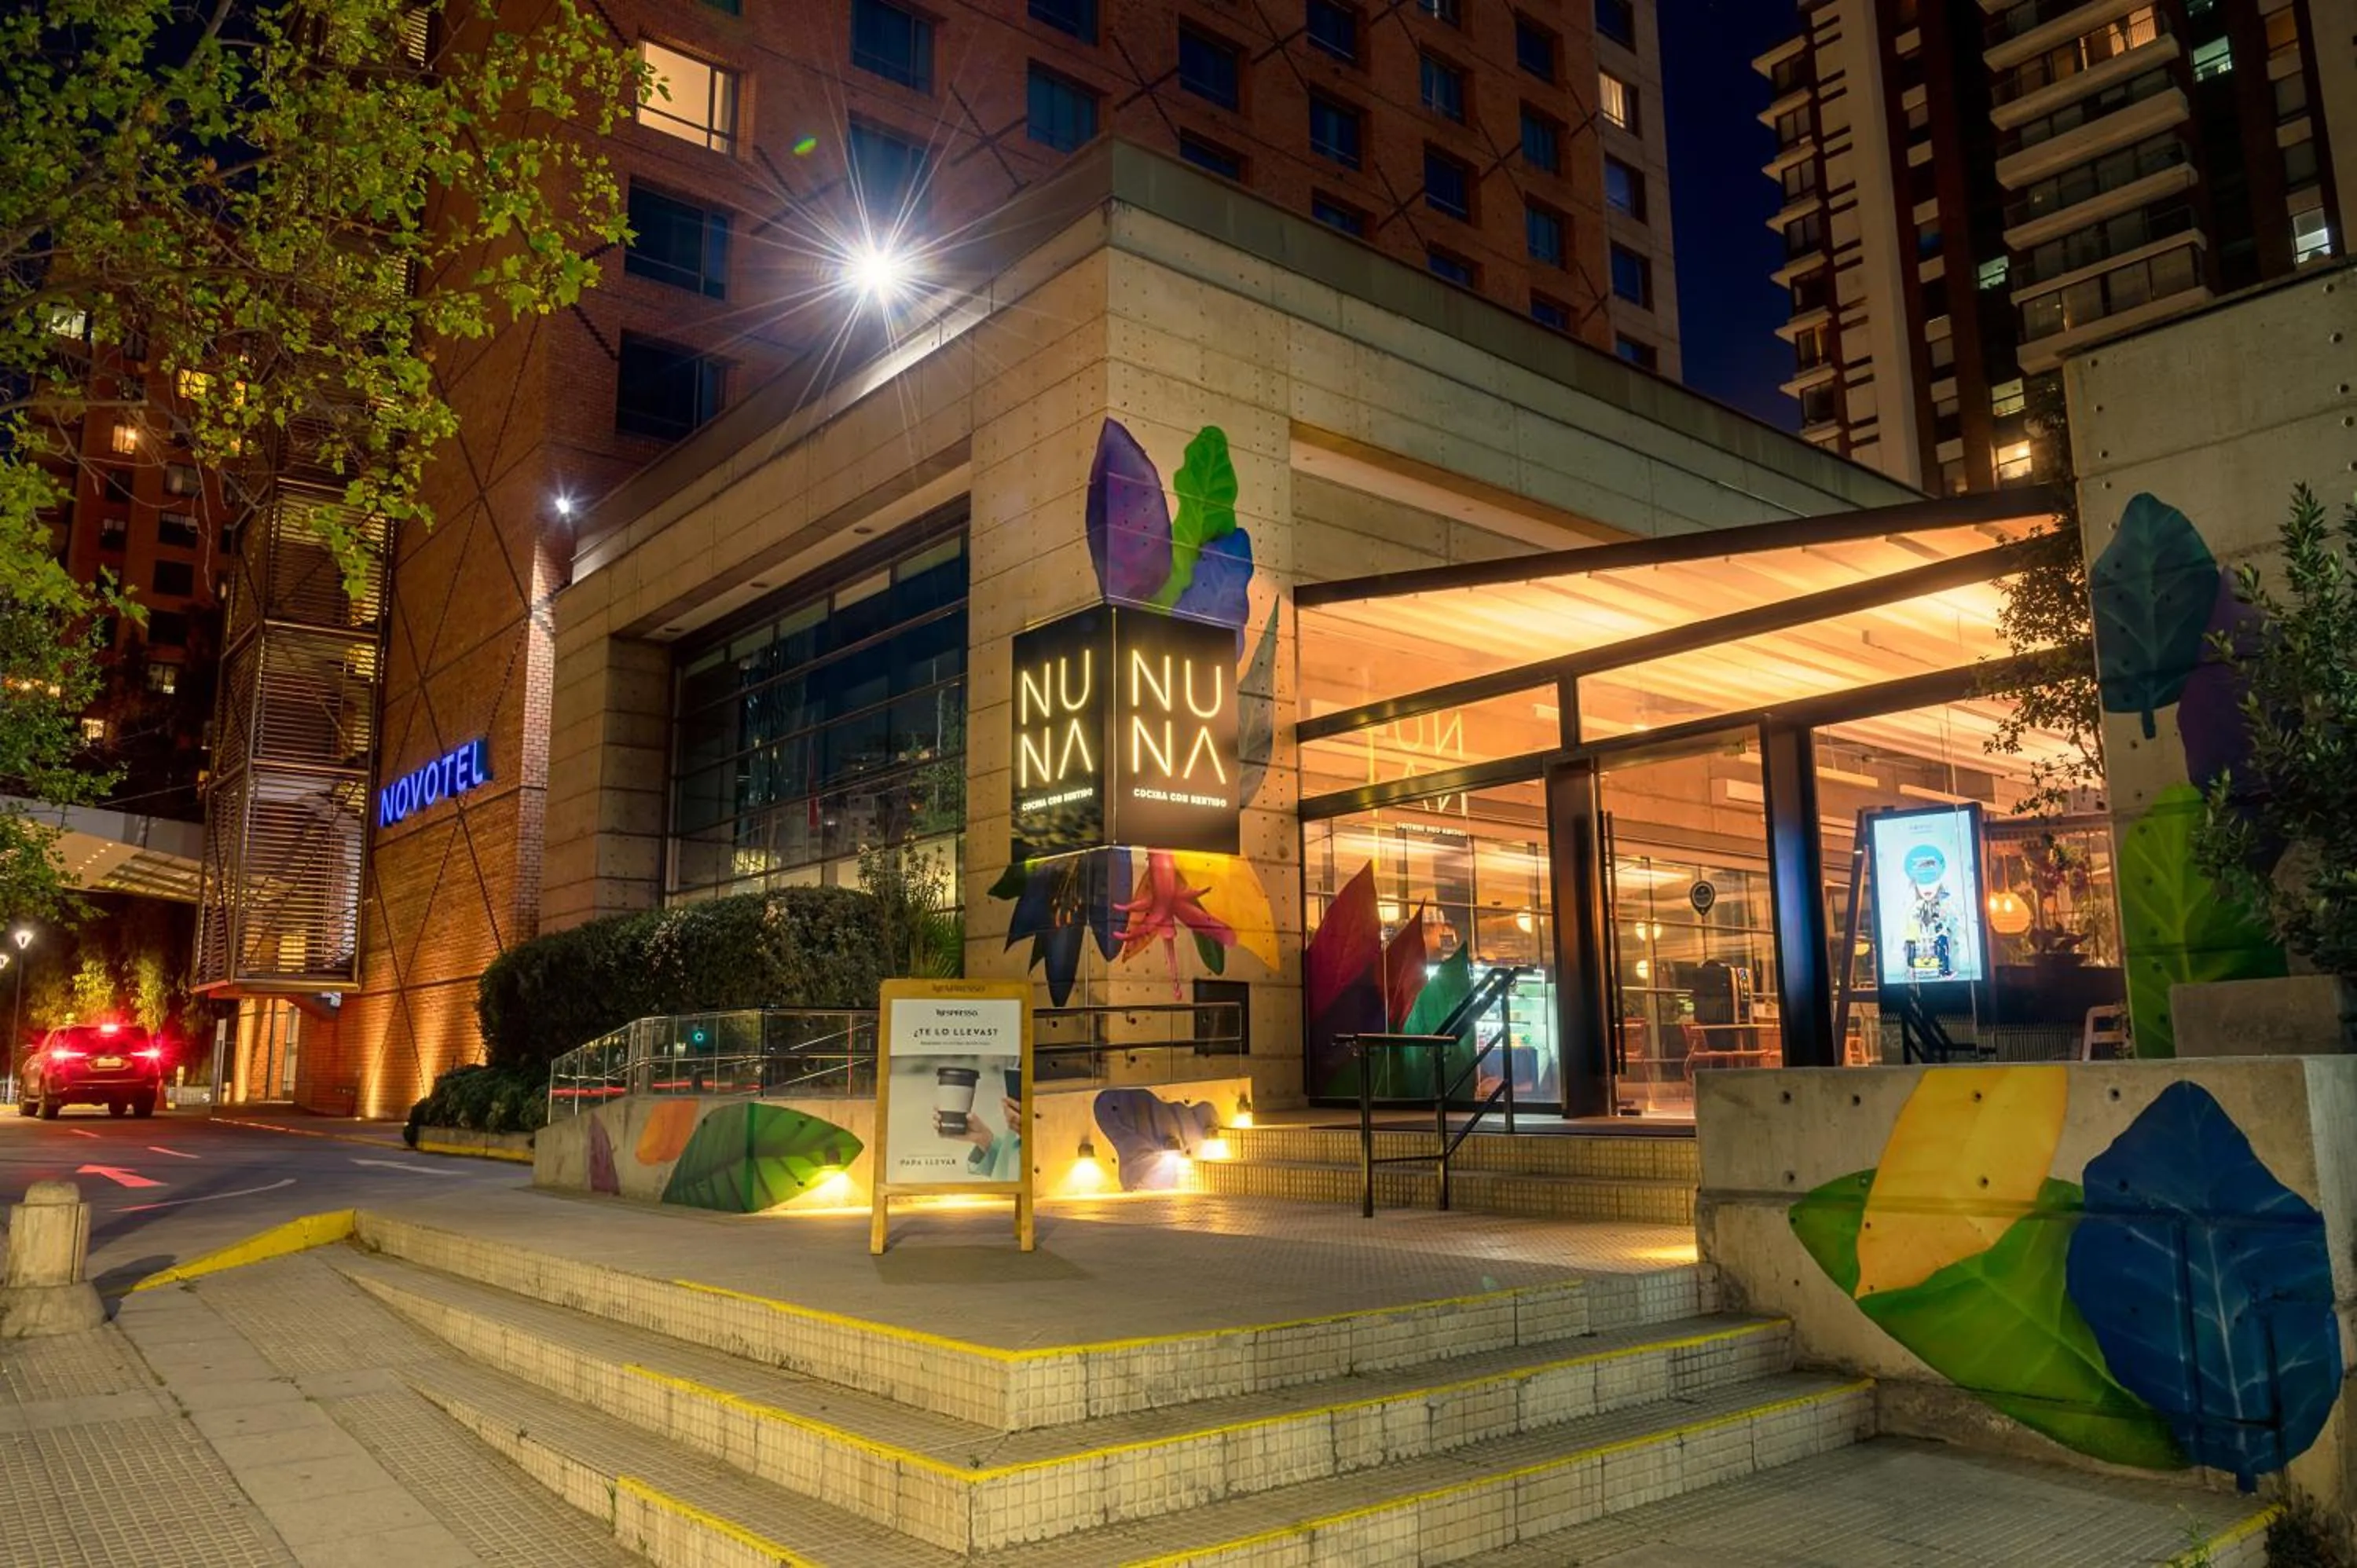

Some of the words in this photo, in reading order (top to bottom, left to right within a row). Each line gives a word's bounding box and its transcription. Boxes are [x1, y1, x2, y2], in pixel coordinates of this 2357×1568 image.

[1021, 648, 1091, 726] NU
[1132, 648, 1222, 719] NU
[379, 739, 485, 828] NOVOTEL
[1021, 717, 1094, 789] NA
[1132, 715, 1226, 785] NA
[1170, 792, 1189, 803] CON
[934, 1028, 950, 1036] LO
